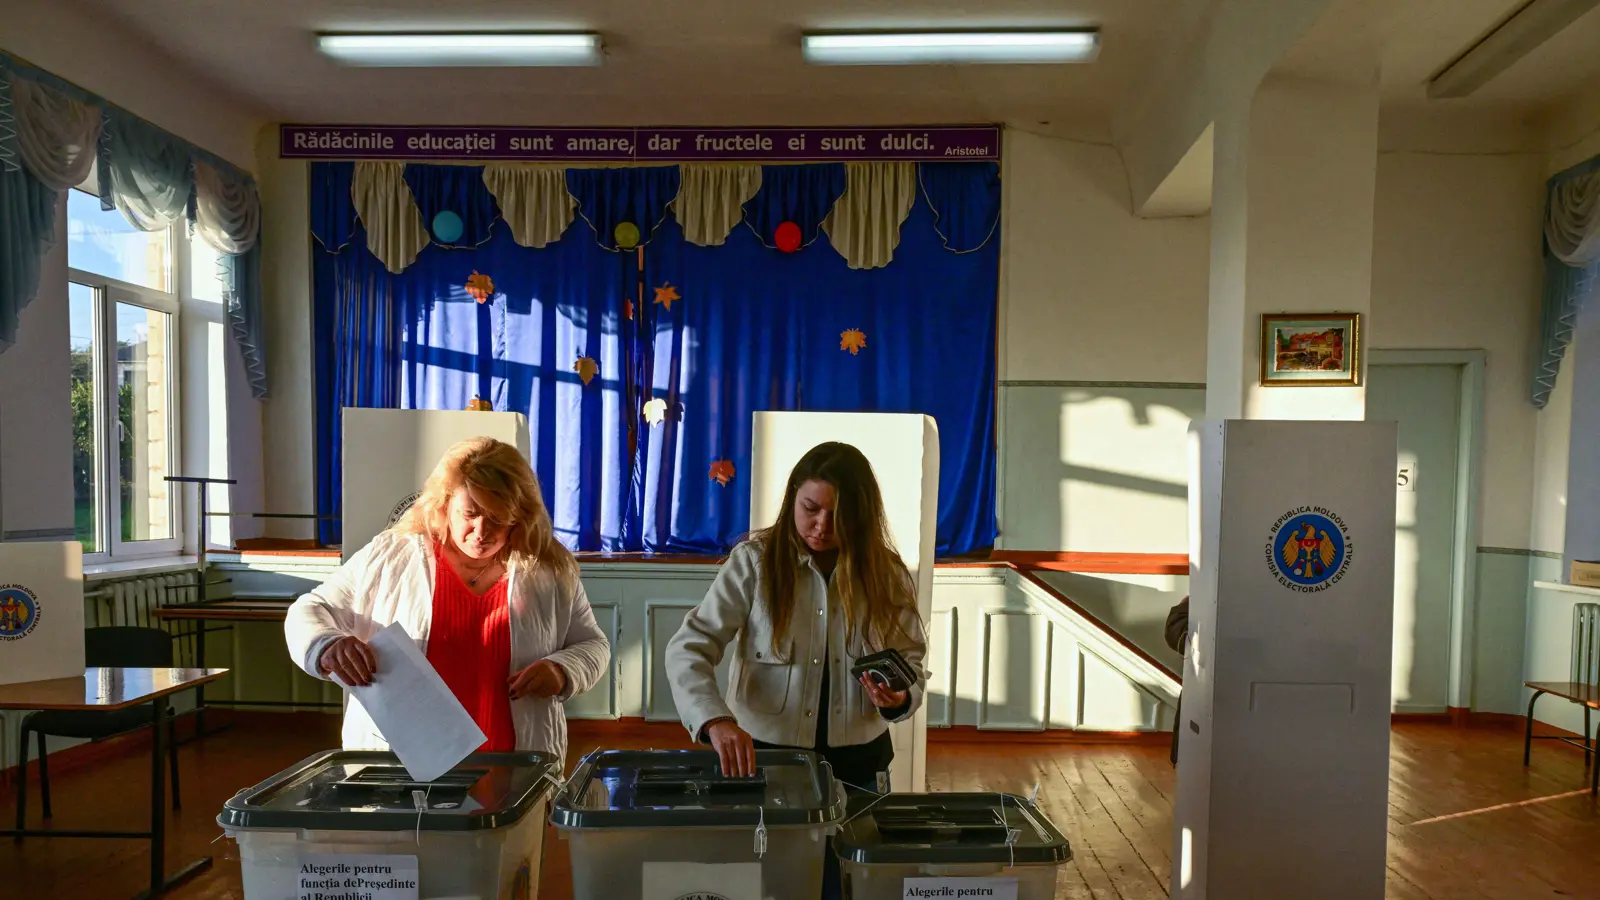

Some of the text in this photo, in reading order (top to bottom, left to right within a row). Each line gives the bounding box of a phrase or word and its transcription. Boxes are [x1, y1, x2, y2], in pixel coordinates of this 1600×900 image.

[293, 131, 935, 155] Rădăcinile educației sunt amare, dar fructele ei sunt dulci.
[944, 145, 989, 156] Aristotel
[1271, 506, 1348, 533] REPUBLICA MOLDOVA
[1264, 543, 1280, 578] COMISIA
[300, 863, 392, 876] Alegerile pentru
[300, 892, 311, 900] al
[905, 886, 993, 899] Alegerile pentru
